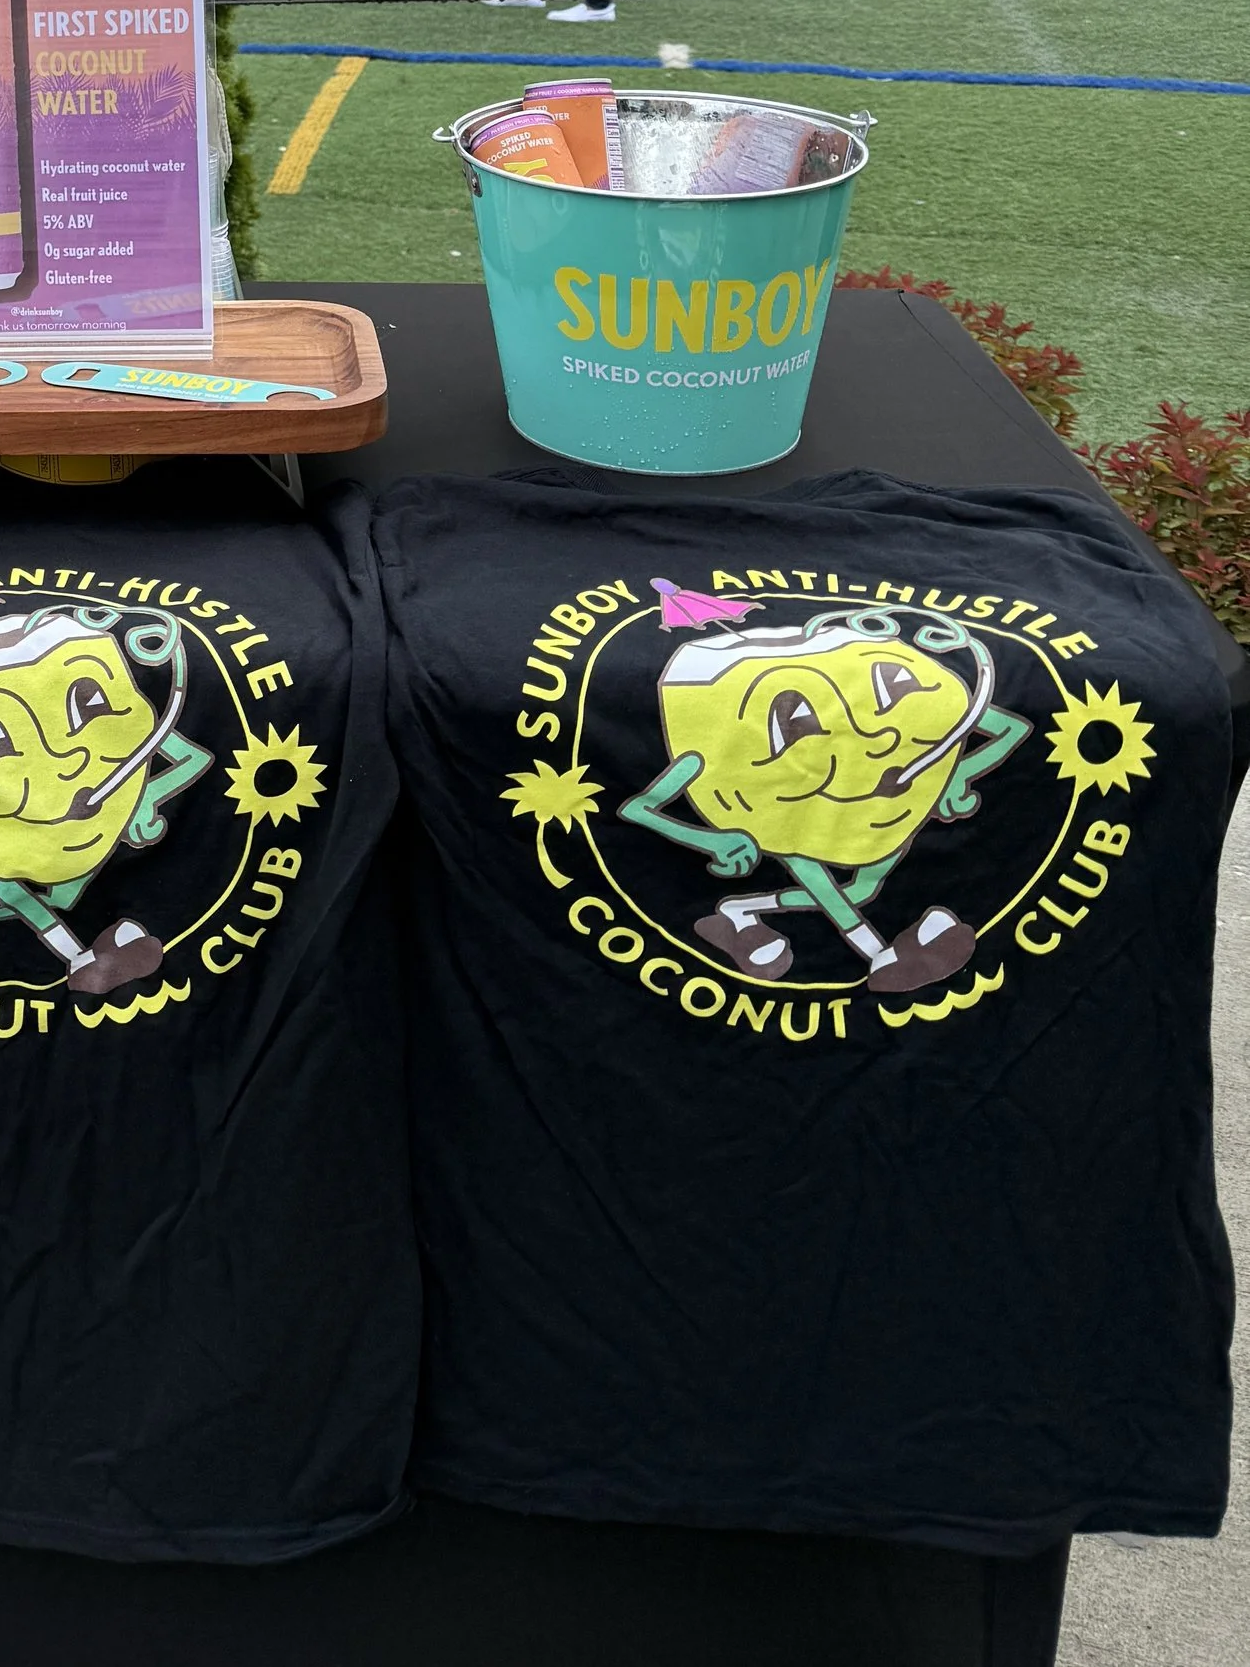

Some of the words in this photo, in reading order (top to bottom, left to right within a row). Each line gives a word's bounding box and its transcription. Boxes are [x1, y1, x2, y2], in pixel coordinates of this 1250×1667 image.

[34, 10, 98, 38] FIRST
[104, 8, 190, 36] SPIKED
[35, 49, 146, 76] COCONUT
[37, 90, 118, 116] WATER
[486, 142, 526, 164] COCONUT
[527, 138, 554, 148] WATER
[500, 132, 531, 147] SPIKED
[40, 160, 100, 176] Hydrating
[102, 160, 150, 173] coconut
[152, 160, 186, 172] water
[42, 187, 68, 202] Real
[71, 187, 96, 202] fruit
[99, 188, 128, 204] juice
[43, 215, 64, 230] 5%
[68, 214, 94, 229] ABV
[63, 246, 96, 260] sugar
[98, 241, 134, 256] added
[46, 270, 113, 284] Gluten-free
[10, 307, 64, 318] @drinksunboy
[554, 258, 831, 354] SUNBOY
[12, 322, 24, 331] us
[26, 322, 79, 330] tomorrow
[82, 320, 127, 332] morning
[562, 356, 640, 384] SPIKED
[646, 366, 762, 388] COCONUT
[766, 350, 810, 380] WATER
[120, 370, 254, 394] SUNBOY
[516, 579, 640, 742] SUNBOY
[712, 569, 1098, 660] ANTI-HUSTLE
[201, 846, 304, 976] CLUB
[568, 895, 852, 1042] COCONUT
[1015, 820, 1130, 956] CLUB
